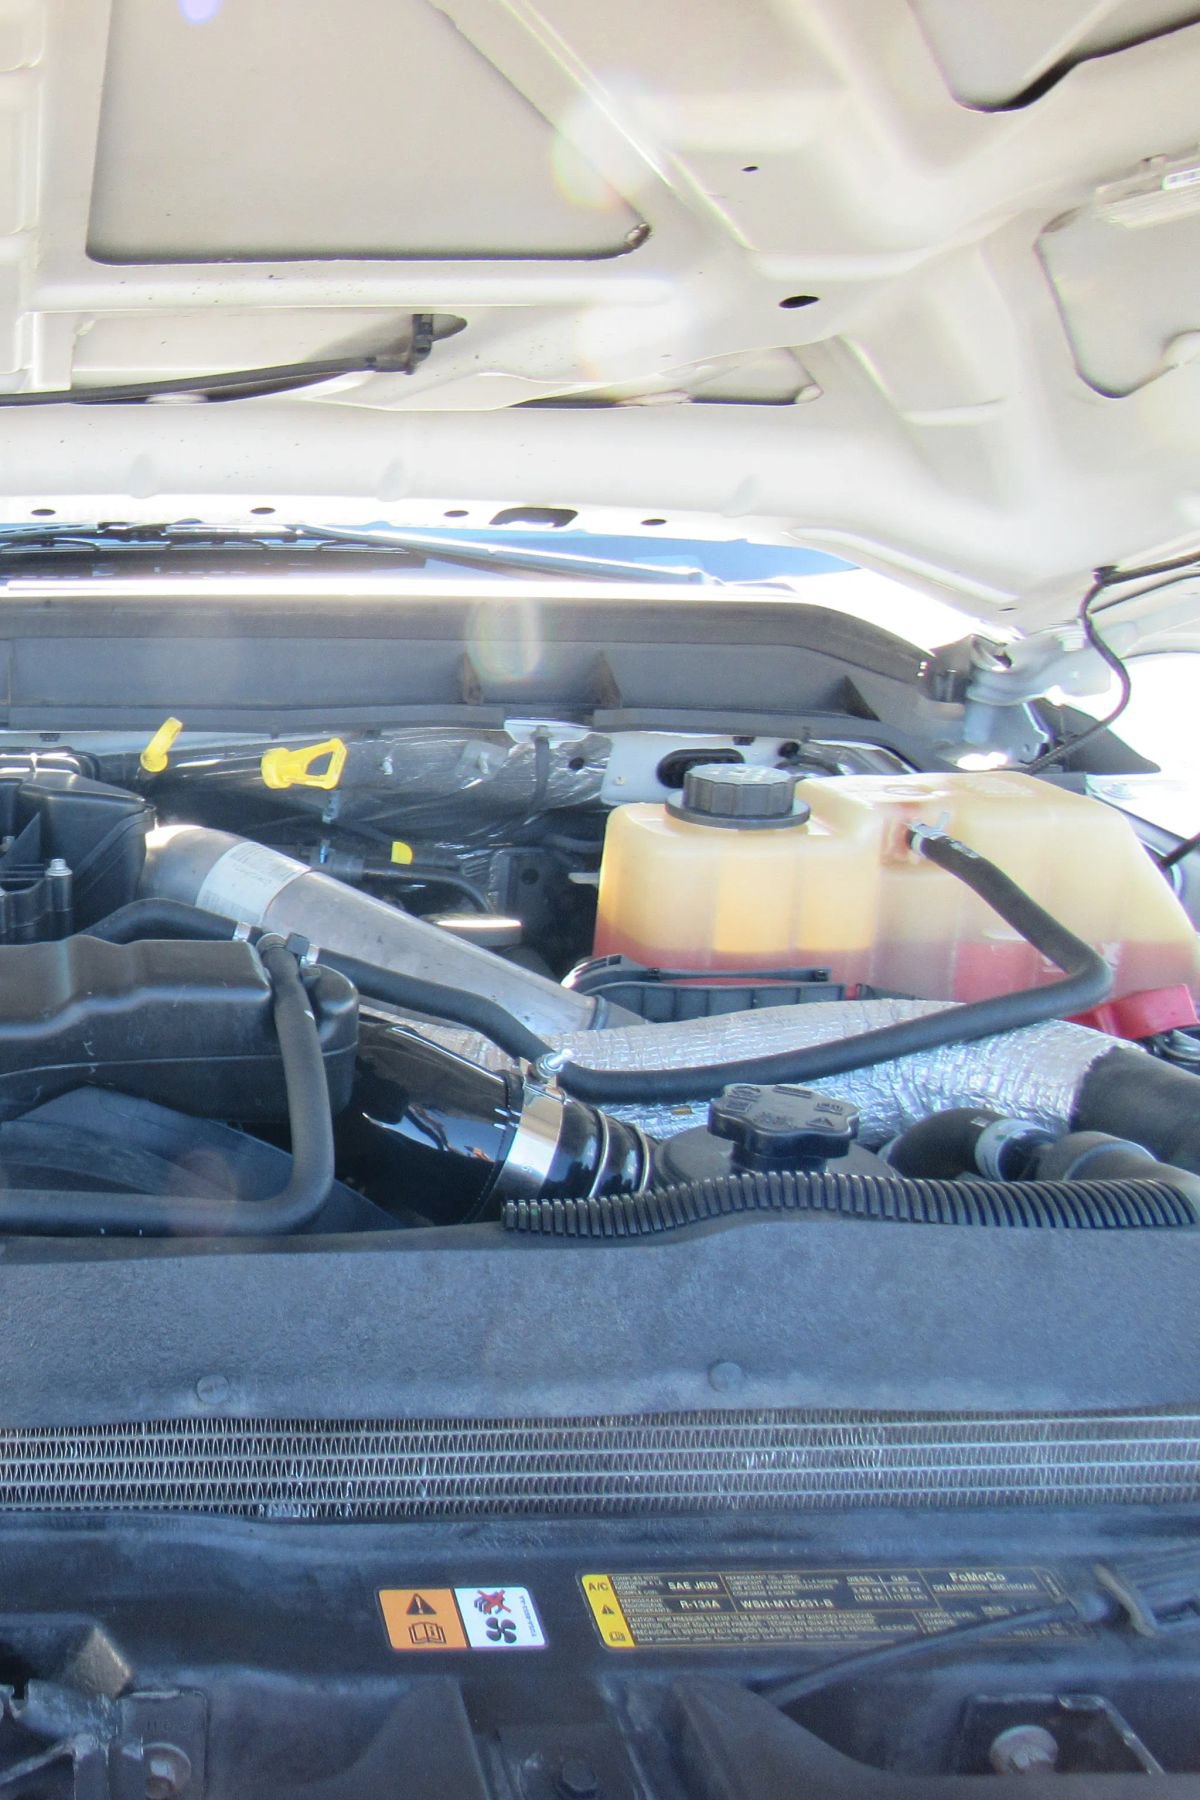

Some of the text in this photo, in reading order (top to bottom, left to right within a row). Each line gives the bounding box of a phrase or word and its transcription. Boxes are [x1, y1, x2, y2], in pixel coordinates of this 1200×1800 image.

[949, 1572, 1006, 1582] FoMoCo
[588, 1582, 609, 1591] A/C
[667, 1581, 691, 1590] SAE
[679, 1600, 721, 1609] R-134A
